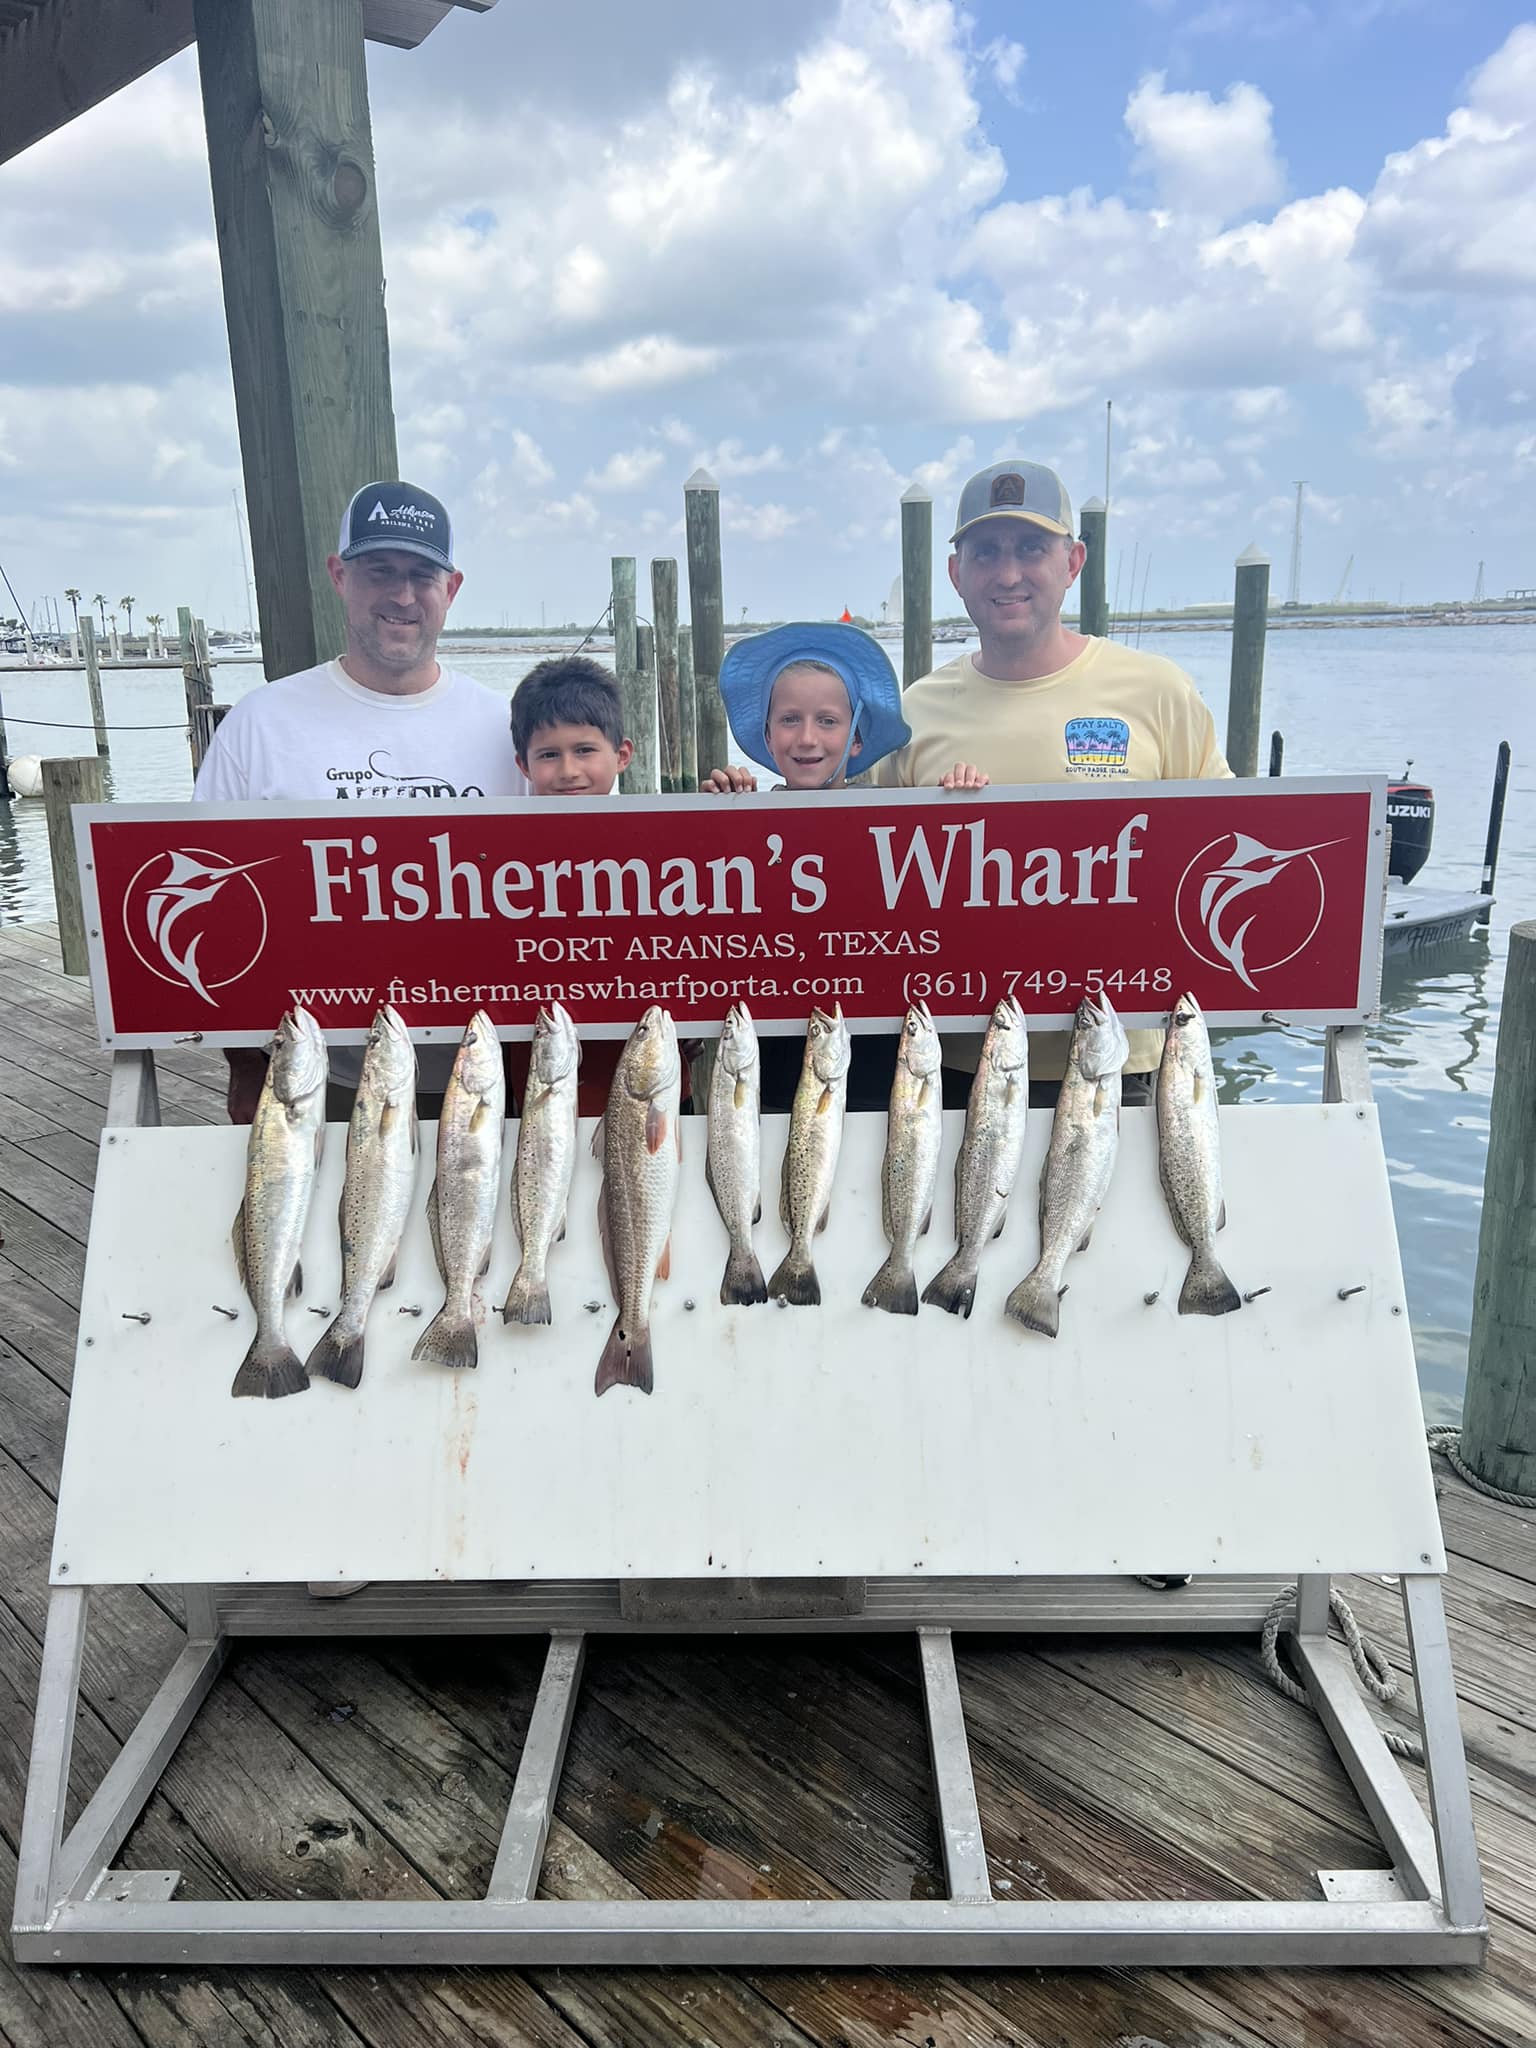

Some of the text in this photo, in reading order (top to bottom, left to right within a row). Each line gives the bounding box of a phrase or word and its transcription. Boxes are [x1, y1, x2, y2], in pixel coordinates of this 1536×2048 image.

[1071, 720, 1125, 731] STAY SALTY
[326, 767, 373, 784] Grupo
[1386, 804, 1431, 819] UZUKI
[303, 813, 1149, 922] Fisherman's Wharf
[515, 929, 941, 963] PORT ARANSAS, TEXAS
[289, 967, 1173, 1006] www.fishermanswharfporta.com (361) 749-5448
